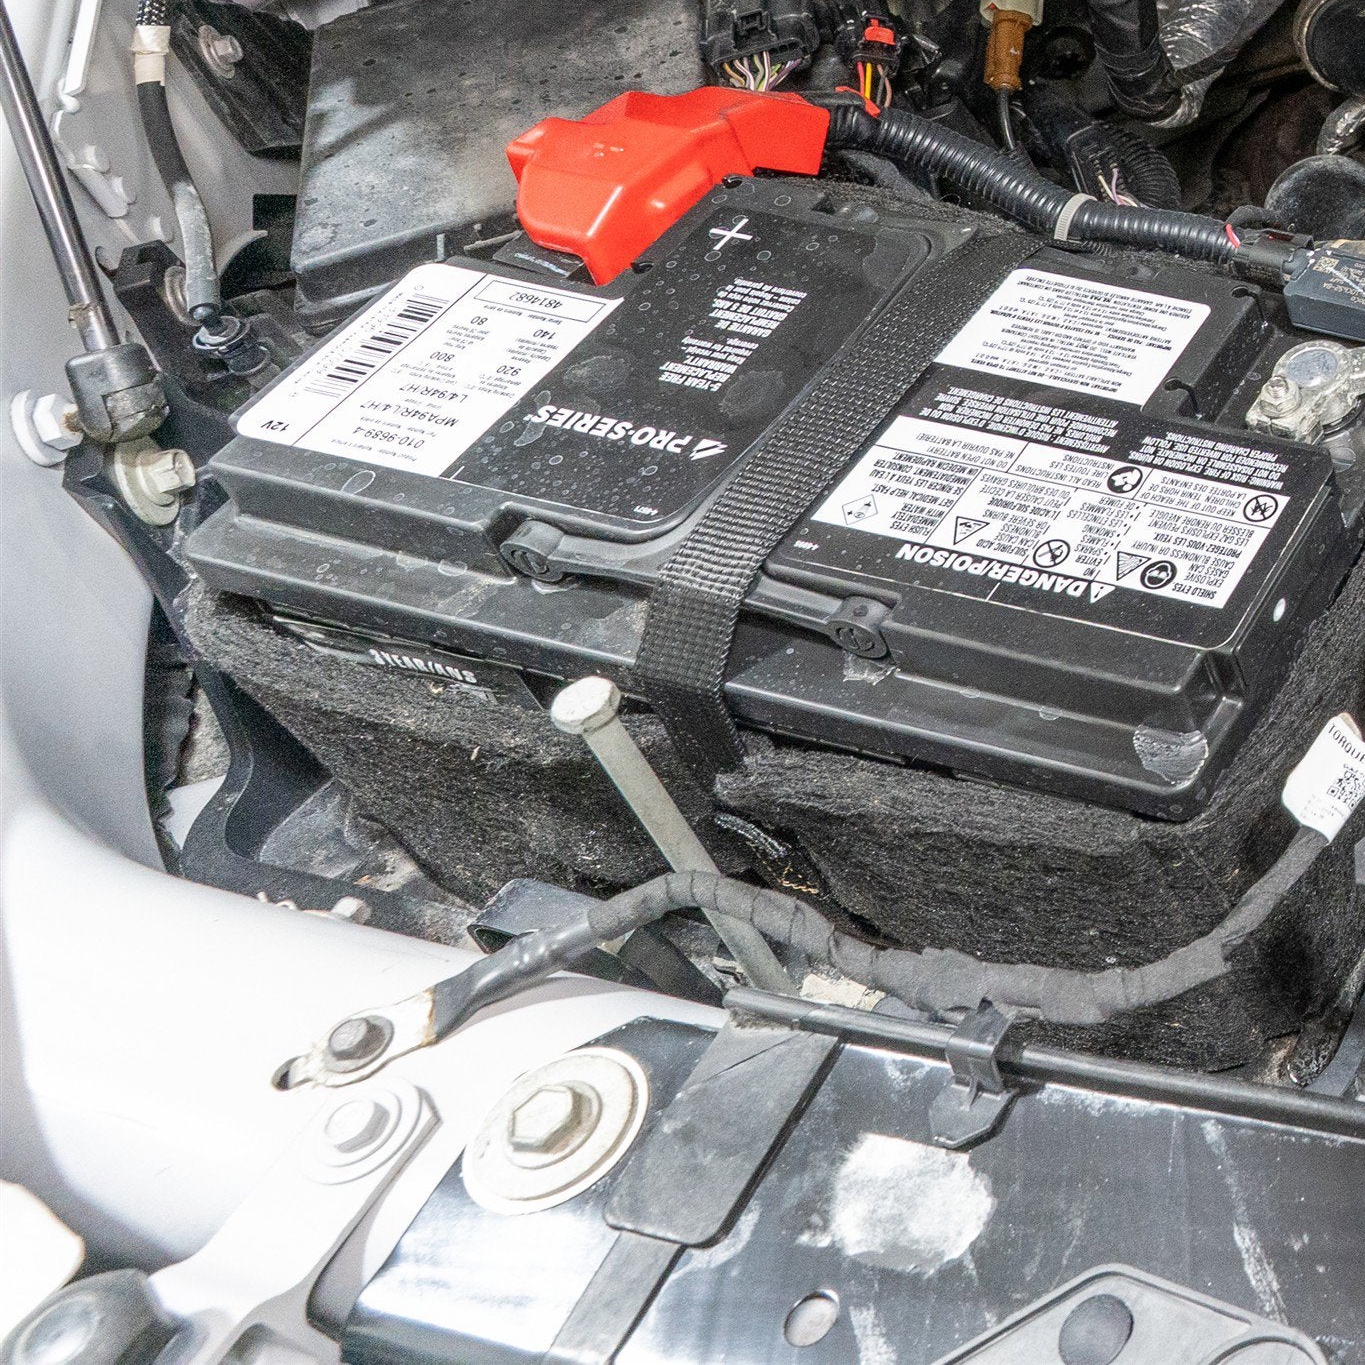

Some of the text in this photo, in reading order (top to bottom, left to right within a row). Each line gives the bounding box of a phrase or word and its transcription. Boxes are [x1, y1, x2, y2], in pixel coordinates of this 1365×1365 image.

[506, 291, 566, 309] 4814682
[735, 303, 753, 313] DE
[747, 306, 788, 320] GRATUIT
[467, 315, 489, 325] 80
[707, 308, 781, 328] REMPLACEMENT
[530, 328, 558, 340] 140
[713, 319, 773, 337] GARANTIE DE
[427, 350, 456, 362] 800
[680, 354, 739, 373] WARRANTY.
[493, 364, 523, 377] 920
[657, 360, 731, 381] REPLACEMENT
[656, 371, 723, 391] 5-YEAR FREE
[397, 381, 469, 404] L4/94R/H7
[259, 418, 292, 432] 12V
[350, 425, 426, 449] 010-9689-4
[949, 439, 963, 447] LA
[960, 441, 990, 453] OUVRIR
[987, 447, 1005, 456] PAS
[958, 452, 982, 462] OPEN
[978, 456, 997, 466] NOT
[1003, 450, 1016, 459] NE
[994, 459, 1009, 468] DO
[1048, 460, 1109, 478] LIRE TOUTES LES
[893, 474, 916, 484] YEUX
[912, 478, 929, 487] LES
[887, 487, 910, 498] HELP
[925, 480, 954, 493] RINCER
[951, 486, 964, 495] SE
[1147, 483, 1160, 491] DE
[1157, 485, 1181, 496] HORS
[906, 491, 940, 504] MEDICAL
[1003, 489, 1016, 498] LA
[1013, 491, 1045, 504] CAUSER
[1179, 489, 1202, 500] TENIR
[937, 497, 955, 507] GET
[986, 496, 1057, 518] L'ACIDE SULFURIQUE
[1042, 497, 1064, 508] PEUT
[1097, 496, 1136, 510] DE FUMER
[1138, 490, 1236, 517] KEEP OUT OF THE REACH OF
[923, 507, 946, 518] WITH
[1078, 502, 1130, 519] LES FLAMMES
[889, 510, 939, 527] IMMEDIATELY
[1180, 515, 1211, 528] RENDRE
[888, 520, 932, 536] FLUSH EYES
[999, 522, 1042, 538] BLINDNESS
[1080, 523, 1117, 537] SMOKING
[1147, 518, 1249, 546] LES GAZ EXPLOSIFS PEUVENT
[1209, 521, 1223, 531] OU
[1220, 524, 1255, 538] BLESSER
[993, 531, 1035, 547] CAN CAUSE
[1079, 533, 1110, 546] FLAMES
[974, 538, 1029, 556] SULFURIC ACID
[1073, 543, 1104, 556] SPARKS
[1157, 545, 1171, 555] OR
[1168, 548, 1211, 564] BLINDNESS
[1209, 556, 1236, 569] CAUSE
[893, 541, 1090, 597] DANGER/POISON
[1081, 567, 1096, 577] NO
[1187, 562, 1230, 578] GASES CAN
[1182, 571, 1224, 587] EXPLOSIVE
[1168, 581, 1217, 599] SHIELD EYES.
